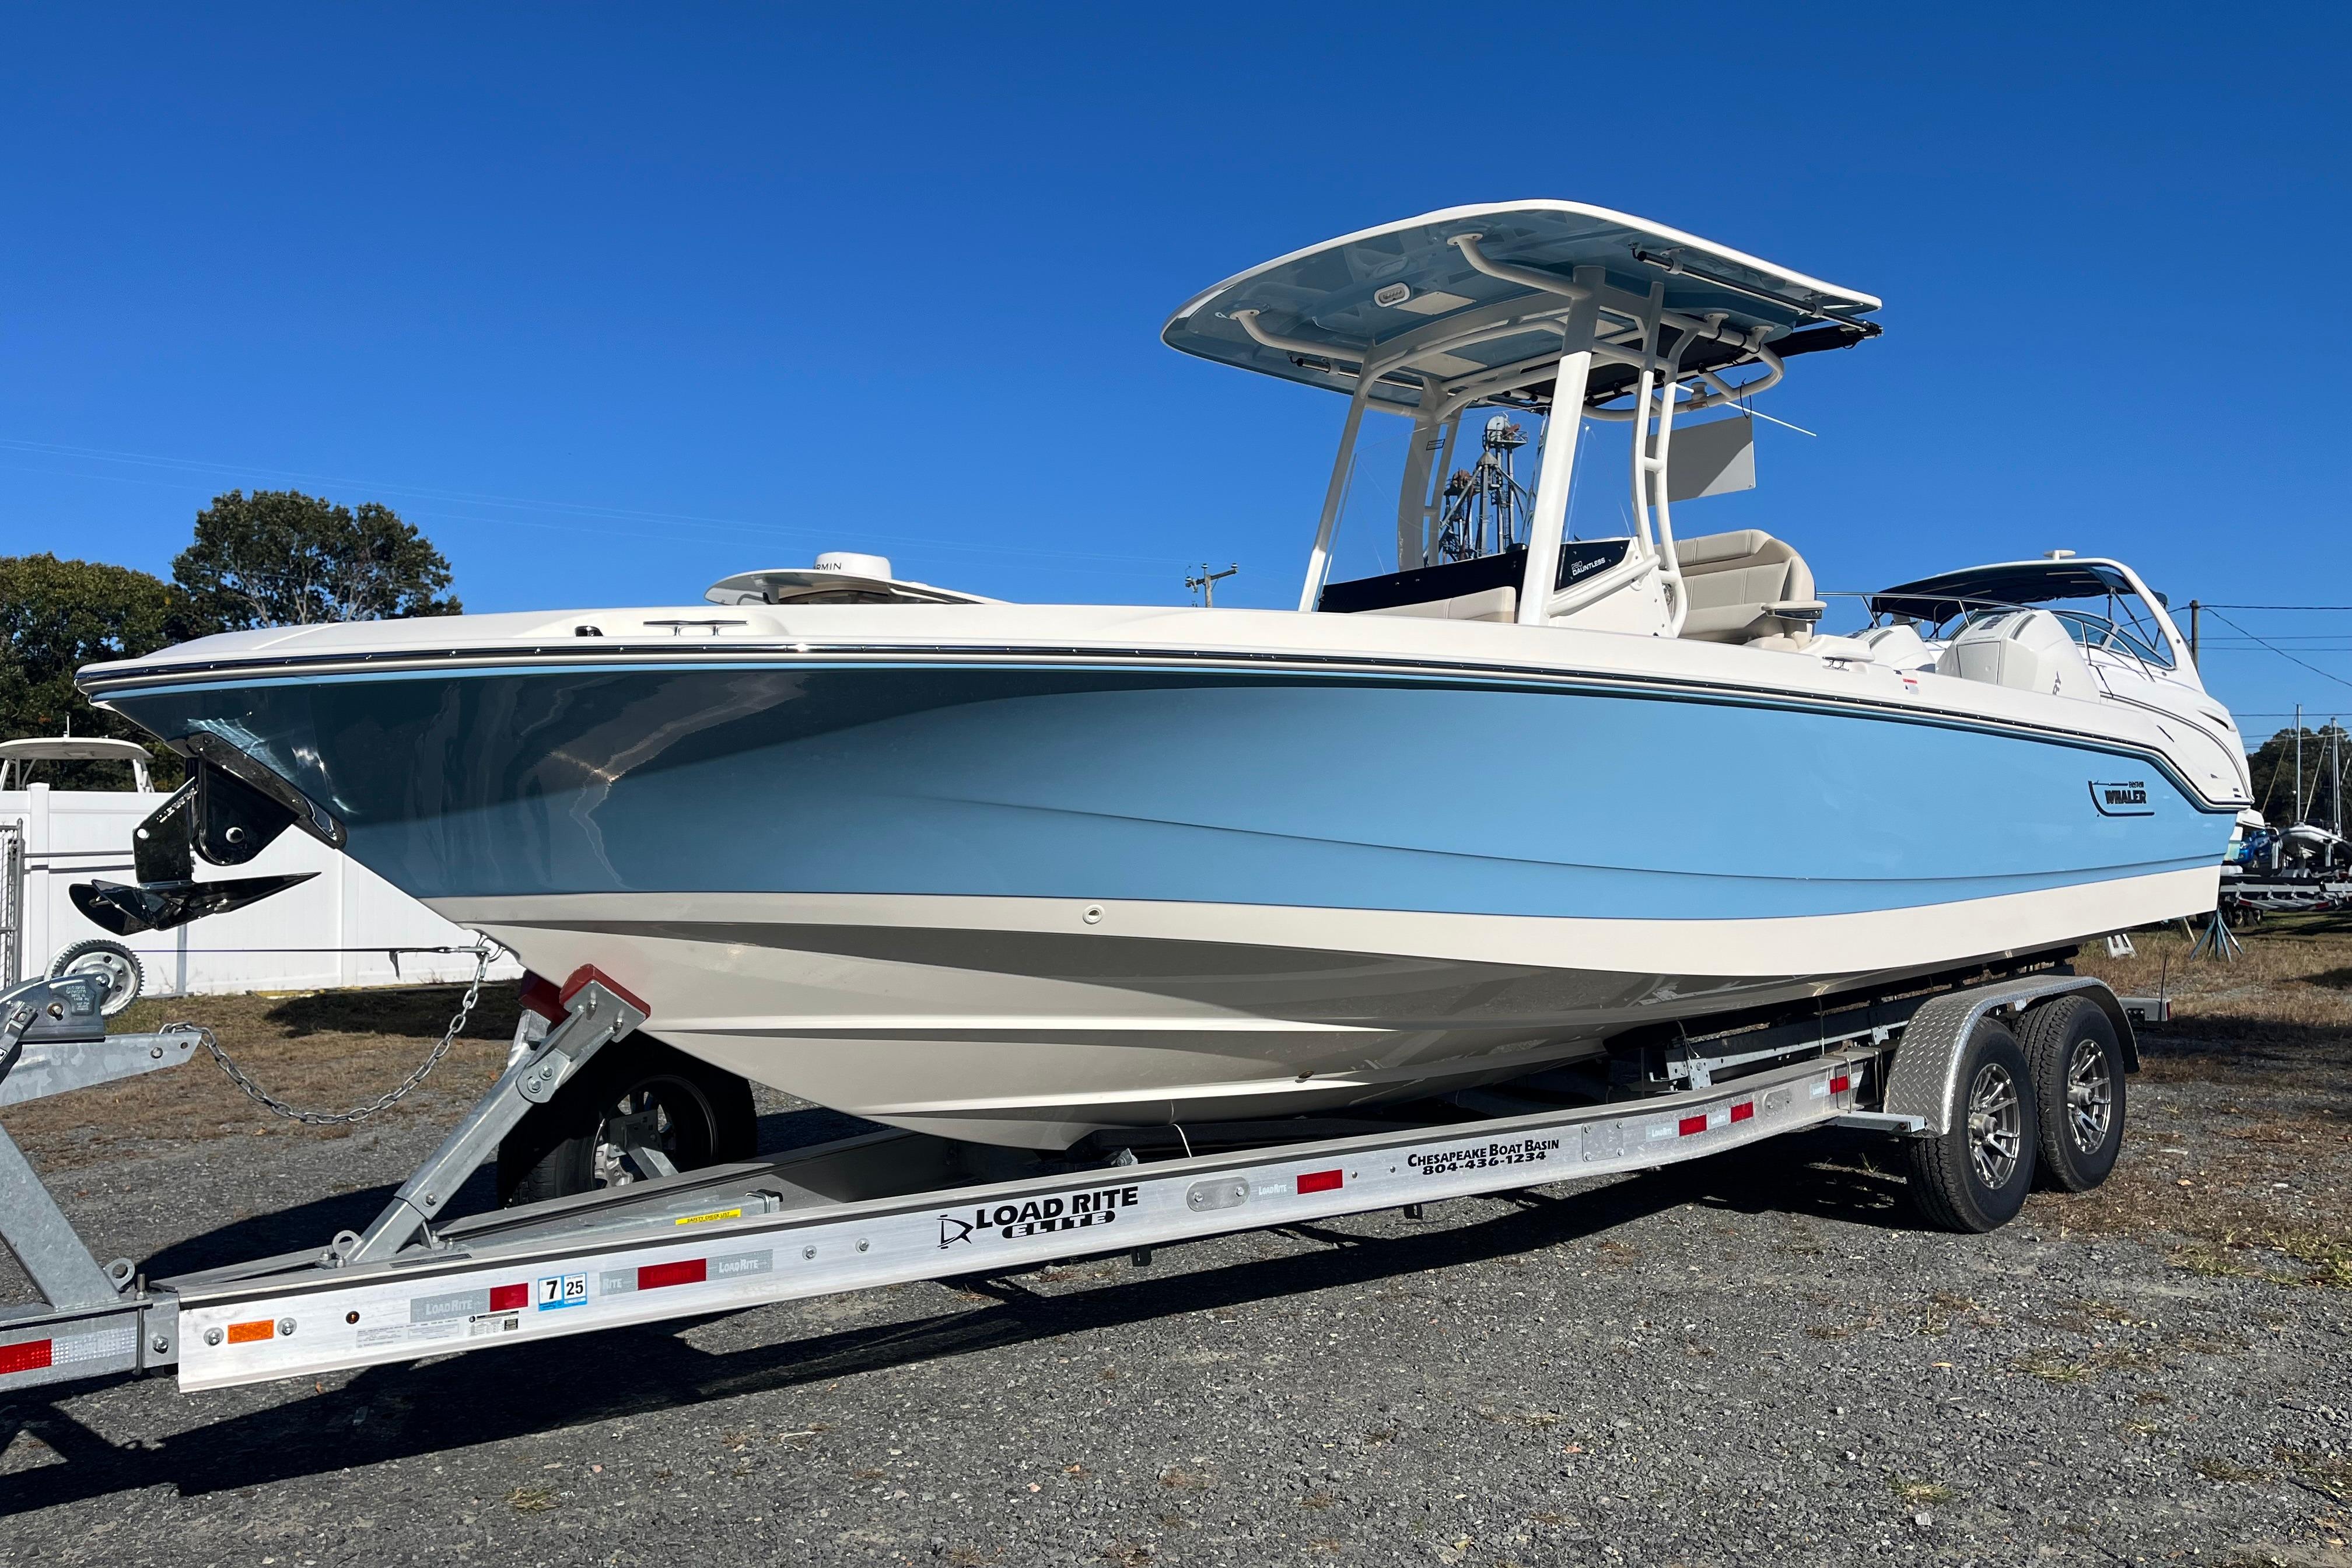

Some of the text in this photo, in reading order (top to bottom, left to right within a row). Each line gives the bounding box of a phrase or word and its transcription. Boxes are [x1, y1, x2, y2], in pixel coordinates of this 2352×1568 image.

[1572, 557, 1605, 576] DAUNTLESS
[2104, 790, 2147, 804] WHALER
[1408, 1139, 1559, 1167] CHESAPEAKE BOAT BASIN
[1422, 1152, 1546, 1175] 804-436-1234
[976, 1186, 1138, 1230] LOAD RITE
[1011, 1212, 1108, 1238] ELITE
[546, 1280, 558, 1300] 7
[566, 1280, 584, 1296] 25
